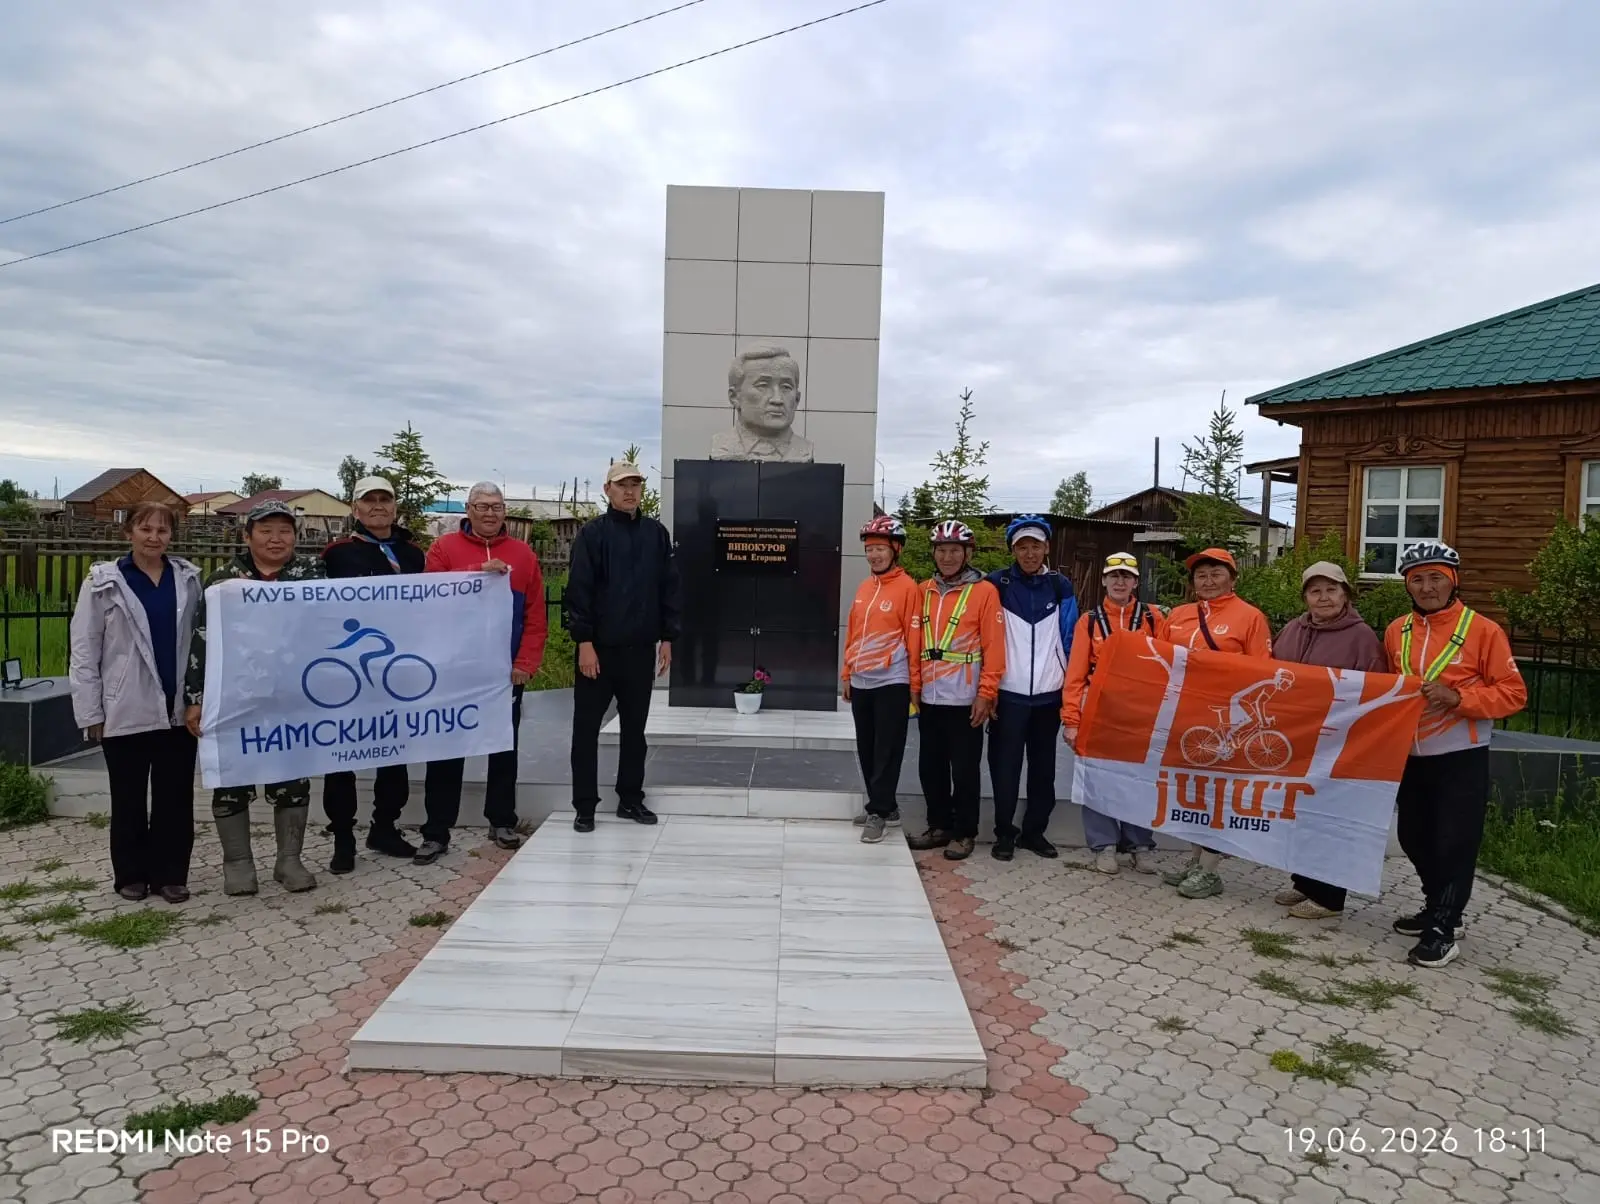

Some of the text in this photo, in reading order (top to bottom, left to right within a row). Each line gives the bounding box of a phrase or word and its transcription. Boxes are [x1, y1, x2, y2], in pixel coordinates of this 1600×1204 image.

[728, 542, 786, 552] ВИНОКУРОВ
[726, 552, 787, 563] Илья Егорович
[242, 579, 483, 603] КЛУБ ВЕЛОСИПЕДИСТОВ
[240, 704, 479, 754] НАМСКИЙ УЛУС
[331, 745, 405, 762] "НАМВЕЛ"
[1171, 808, 1271, 833] ВЕЛО КЛУБ
